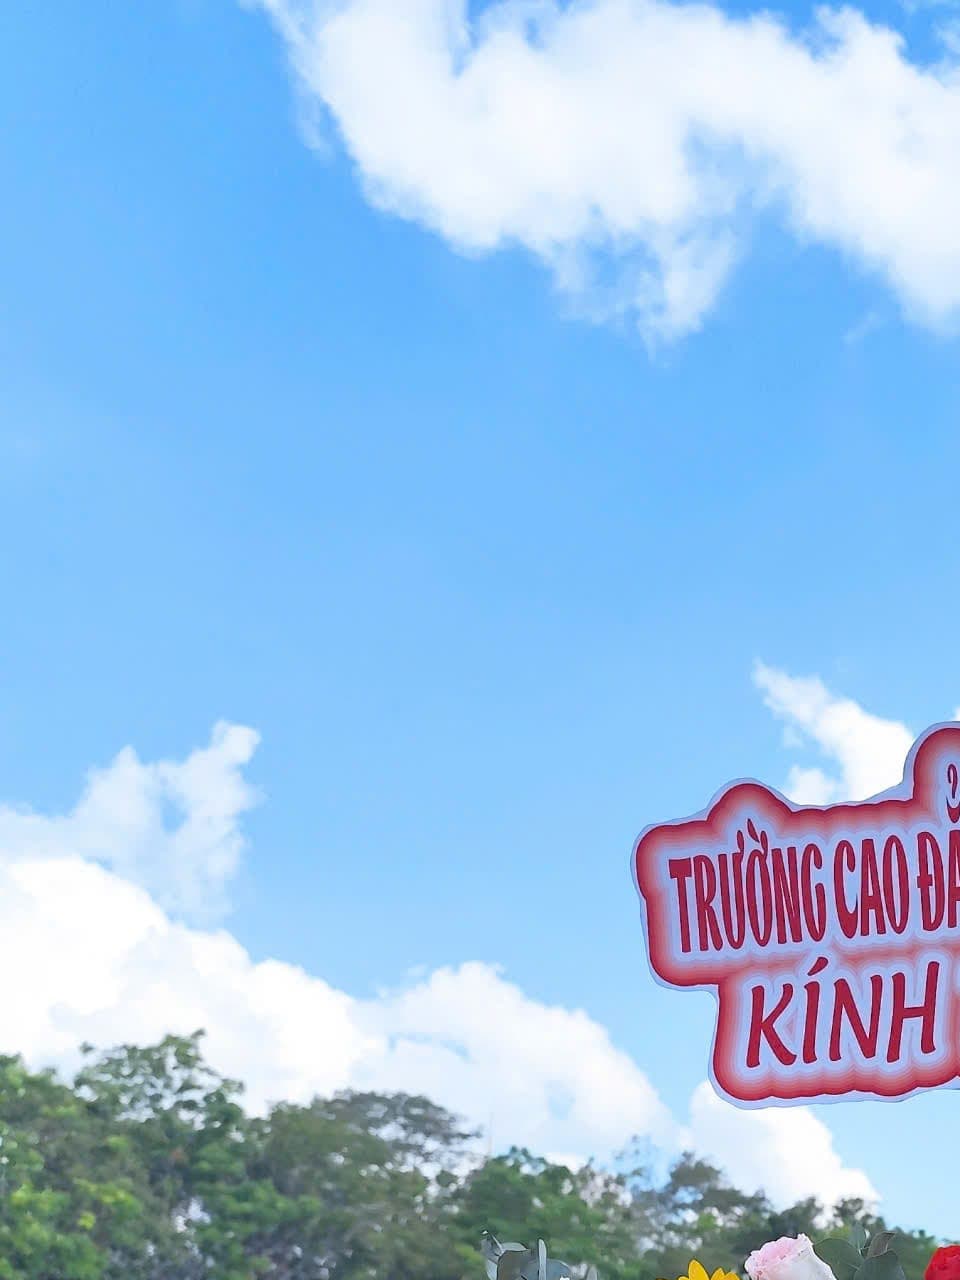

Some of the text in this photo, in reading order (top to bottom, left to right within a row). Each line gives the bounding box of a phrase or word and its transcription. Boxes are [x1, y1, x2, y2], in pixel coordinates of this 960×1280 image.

[668, 818, 827, 953] TRƯỜNG
[833, 834, 910, 939] CAO
[746, 957, 940, 1069] KÍNH
